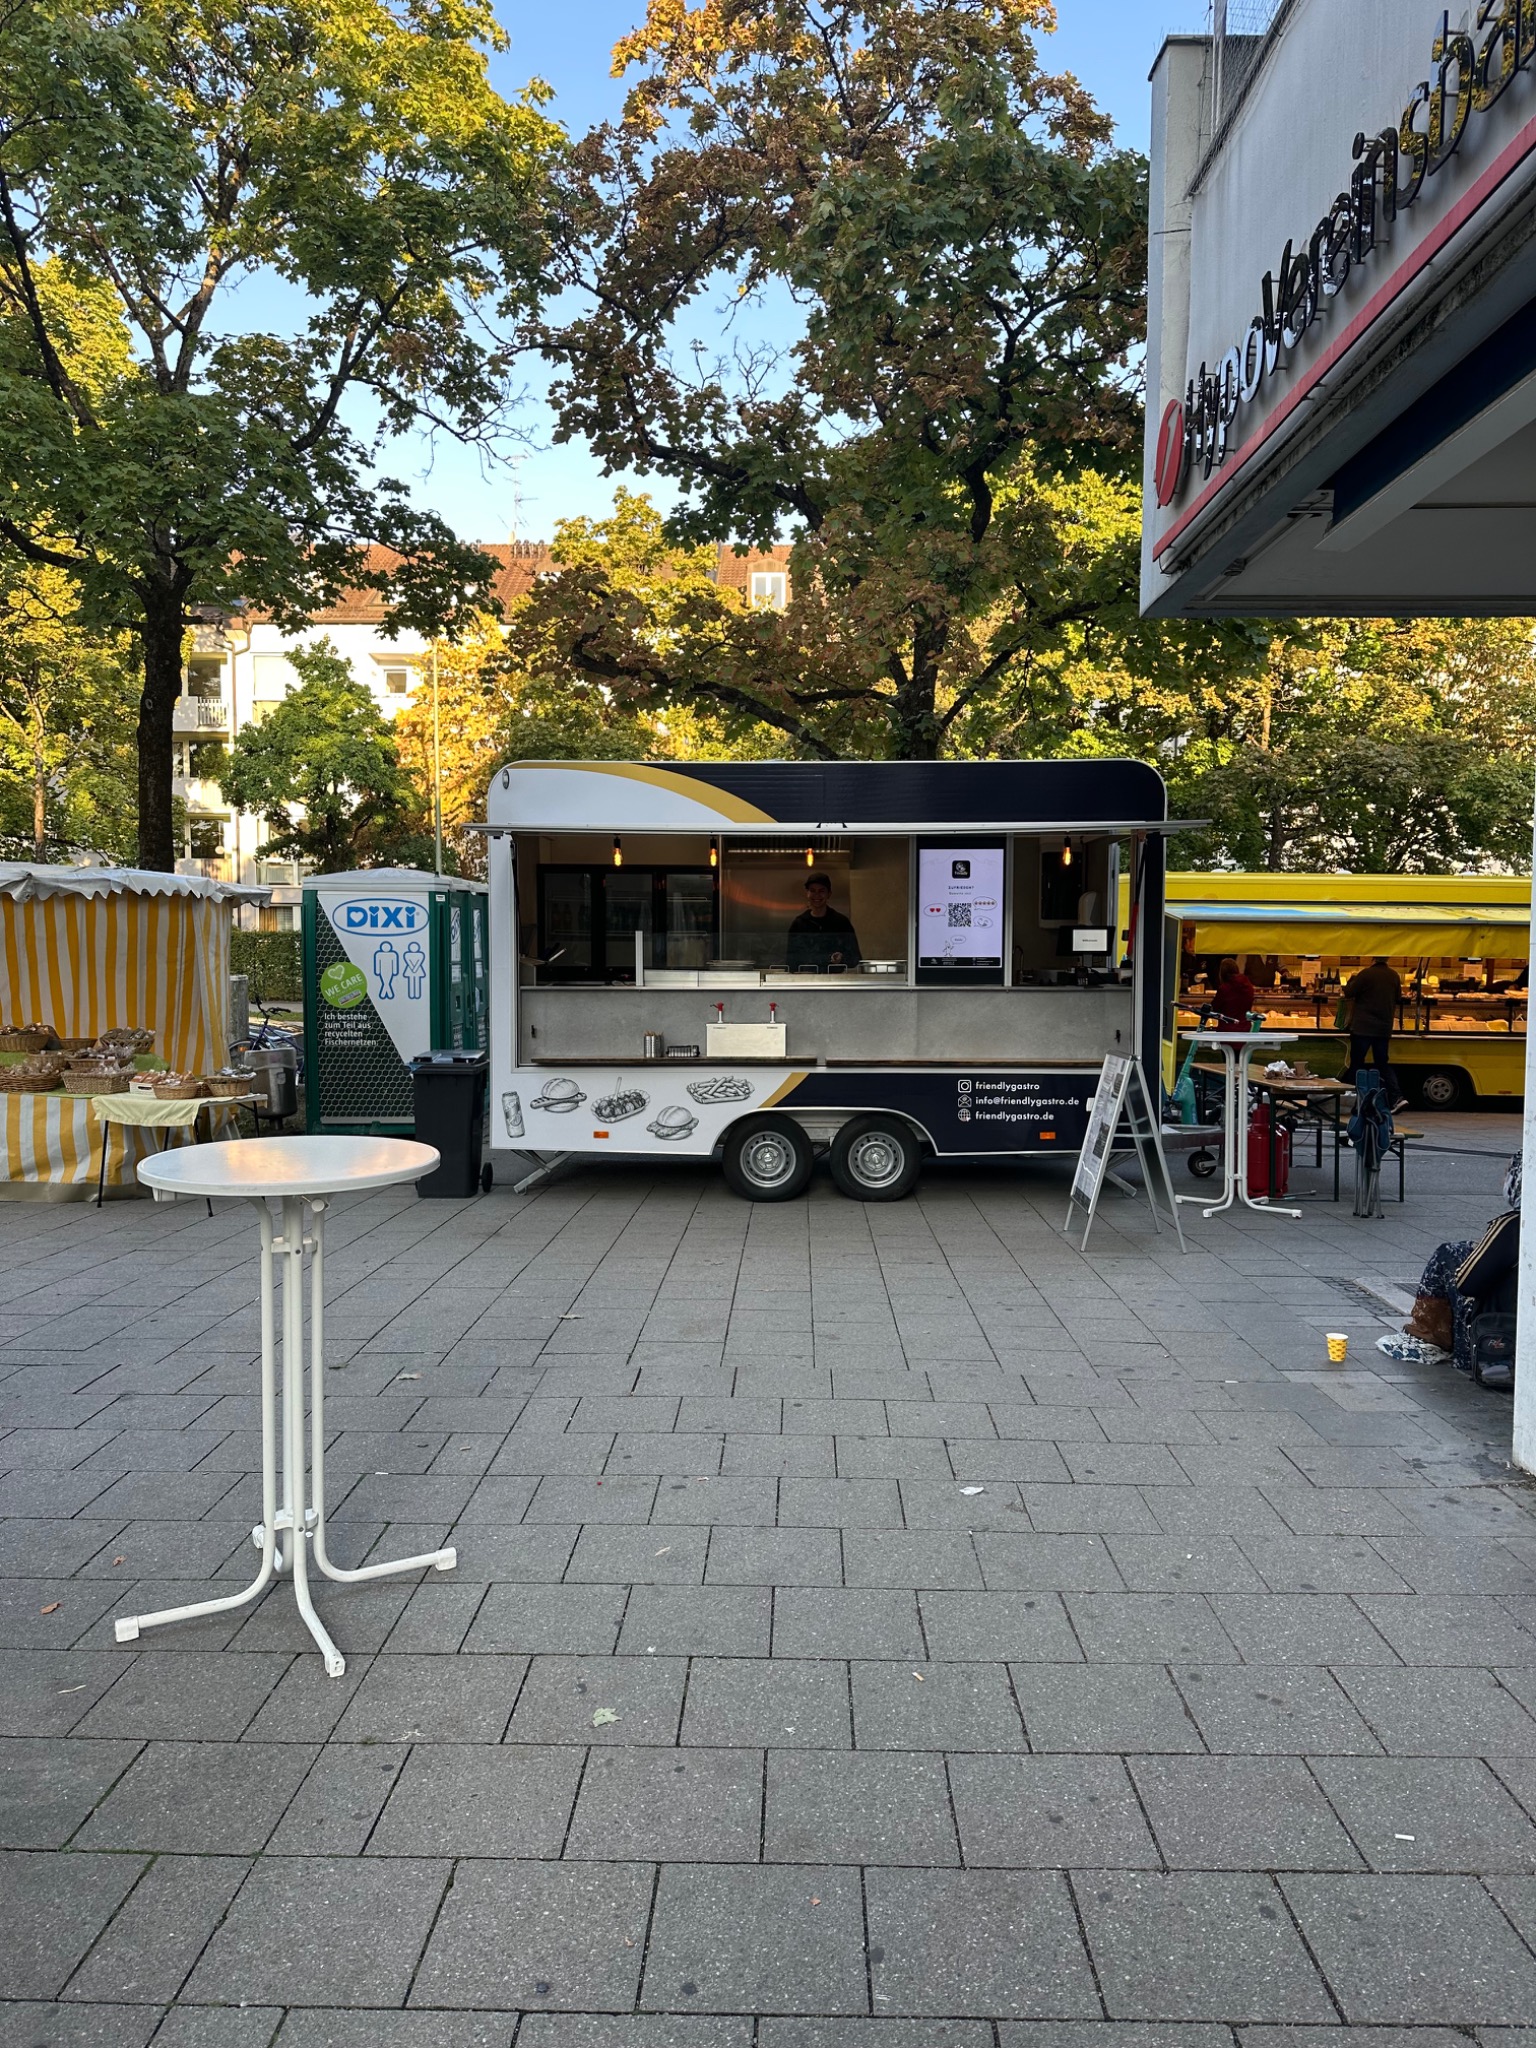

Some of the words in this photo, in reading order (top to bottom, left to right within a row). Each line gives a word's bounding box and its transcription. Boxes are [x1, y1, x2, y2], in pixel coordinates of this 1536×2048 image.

[325, 984, 341, 997] WE
[341, 973, 363, 989] CARE
[324, 1012, 336, 1020] Ich
[337, 1012, 368, 1020] bestehe
[342, 1021, 356, 1029] Teil
[324, 1030, 363, 1039] recycelten
[975, 1081, 1040, 1092] friendlygastro
[975, 1096, 1080, 1107] info@friendlygastro.de
[975, 1111, 1055, 1122] friendlygastro.de
